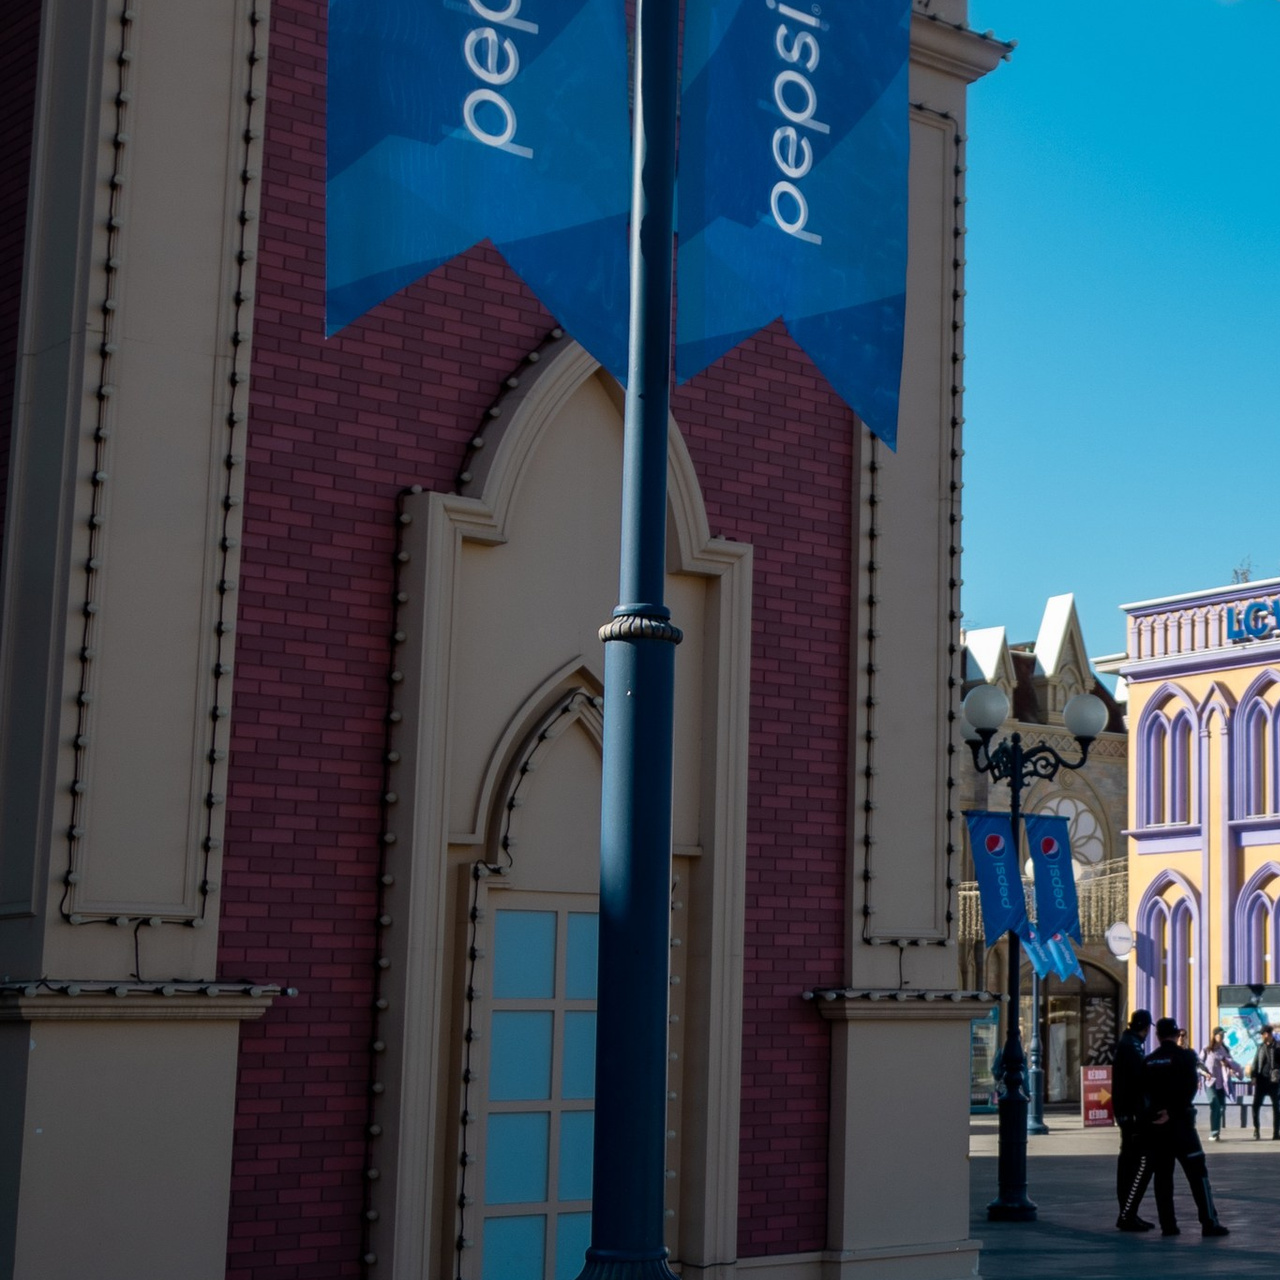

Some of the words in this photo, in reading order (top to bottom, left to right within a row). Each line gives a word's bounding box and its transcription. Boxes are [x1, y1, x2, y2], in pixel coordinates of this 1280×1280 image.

[1226, 600, 1272, 640] LC
[993, 862, 1013, 909] pepsi
[1047, 864, 1067, 910] pepsi
